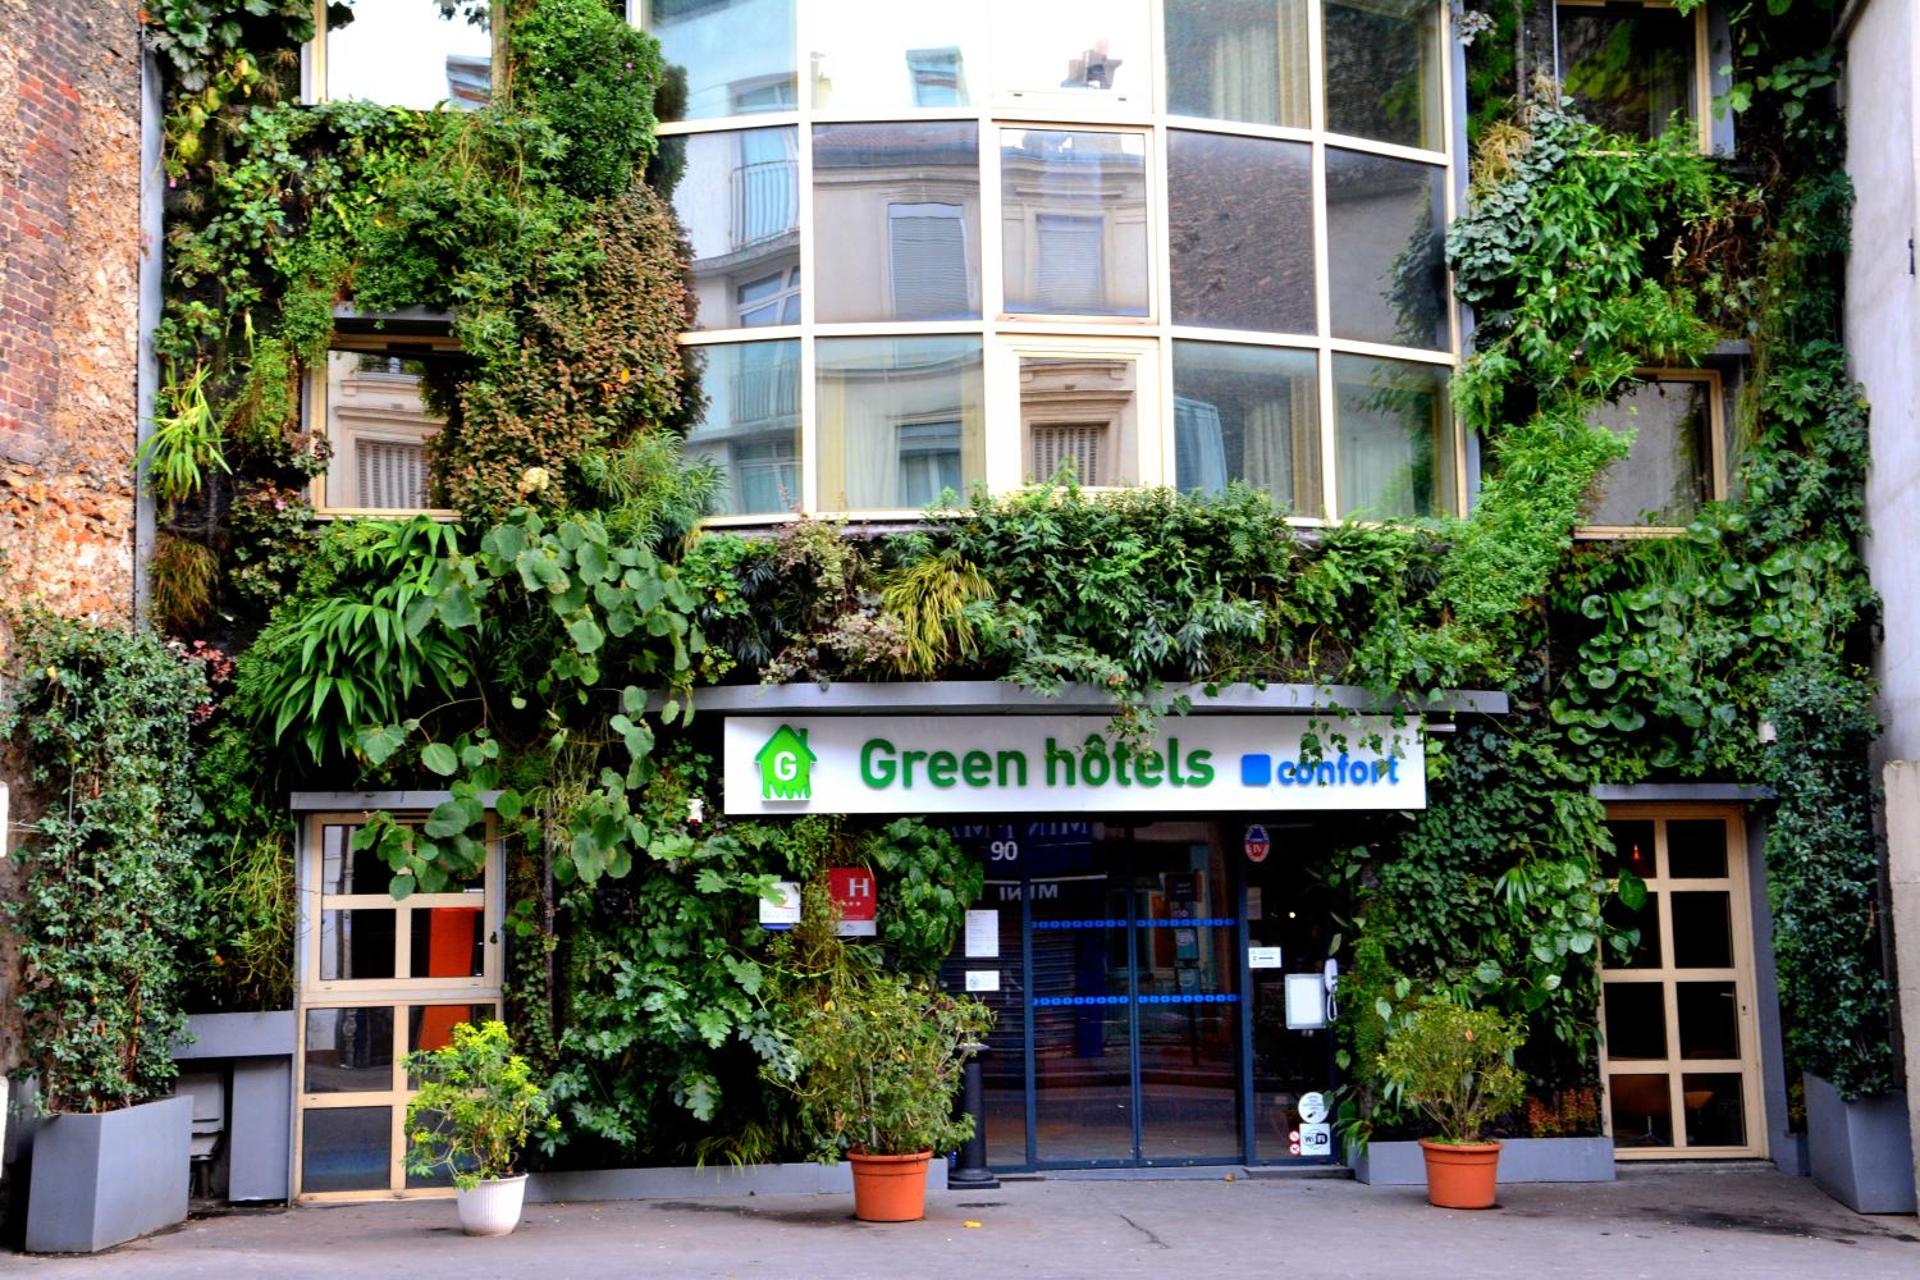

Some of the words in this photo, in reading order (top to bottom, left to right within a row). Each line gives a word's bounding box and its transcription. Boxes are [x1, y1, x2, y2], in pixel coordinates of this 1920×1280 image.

[774, 751, 797, 782] G
[861, 738, 1027, 789] Green
[1046, 733, 1215, 788] hôtels
[1277, 753, 1399, 786] confort
[990, 841, 1018, 861] 90
[849, 878, 870, 897] H
